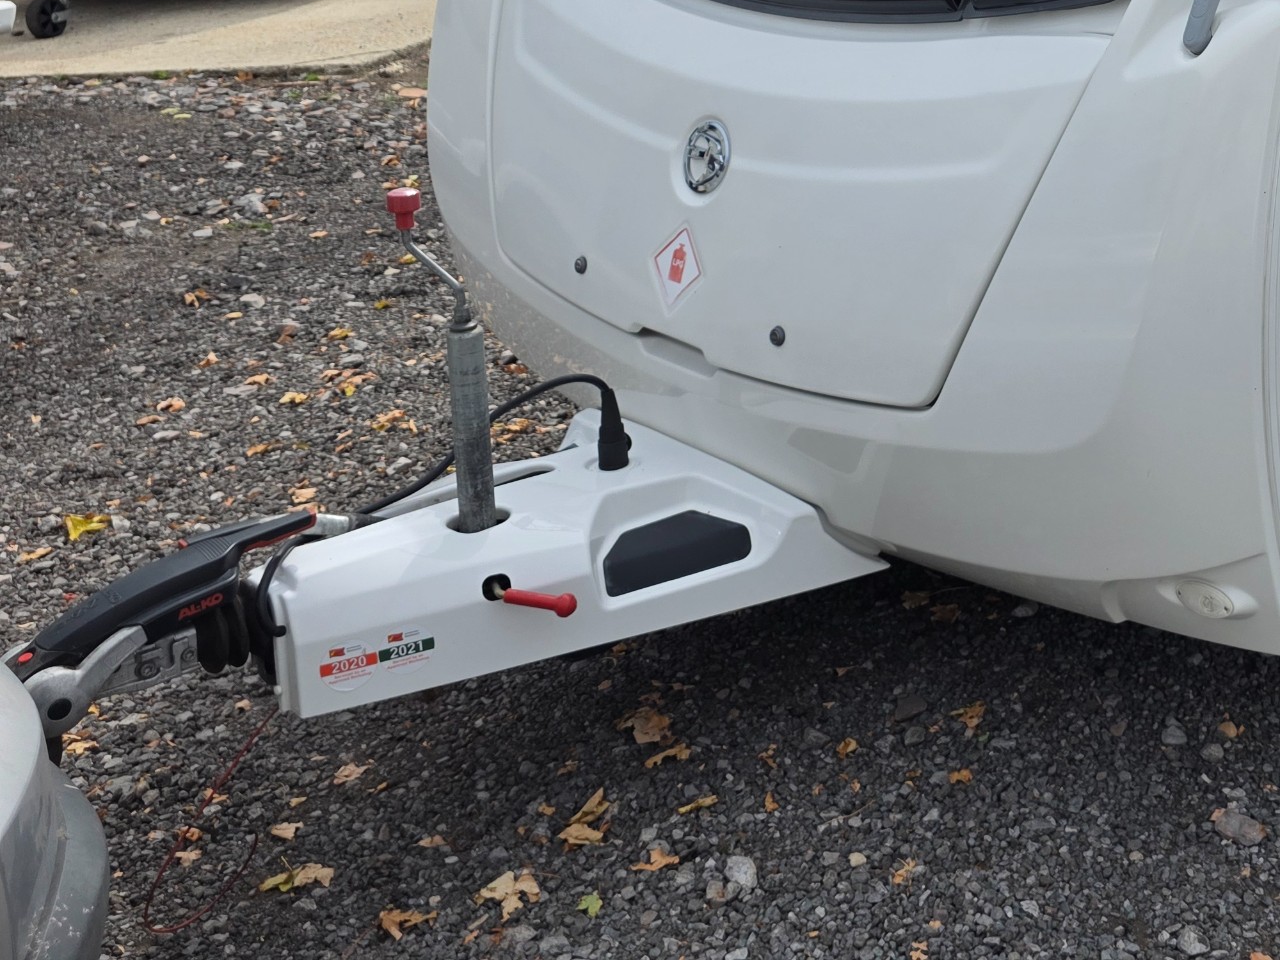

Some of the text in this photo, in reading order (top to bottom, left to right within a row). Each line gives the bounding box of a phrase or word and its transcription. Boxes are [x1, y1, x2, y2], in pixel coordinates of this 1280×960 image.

[178, 593, 224, 621] AL-KO
[390, 640, 424, 659] 2021
[331, 655, 367, 674] 2020
